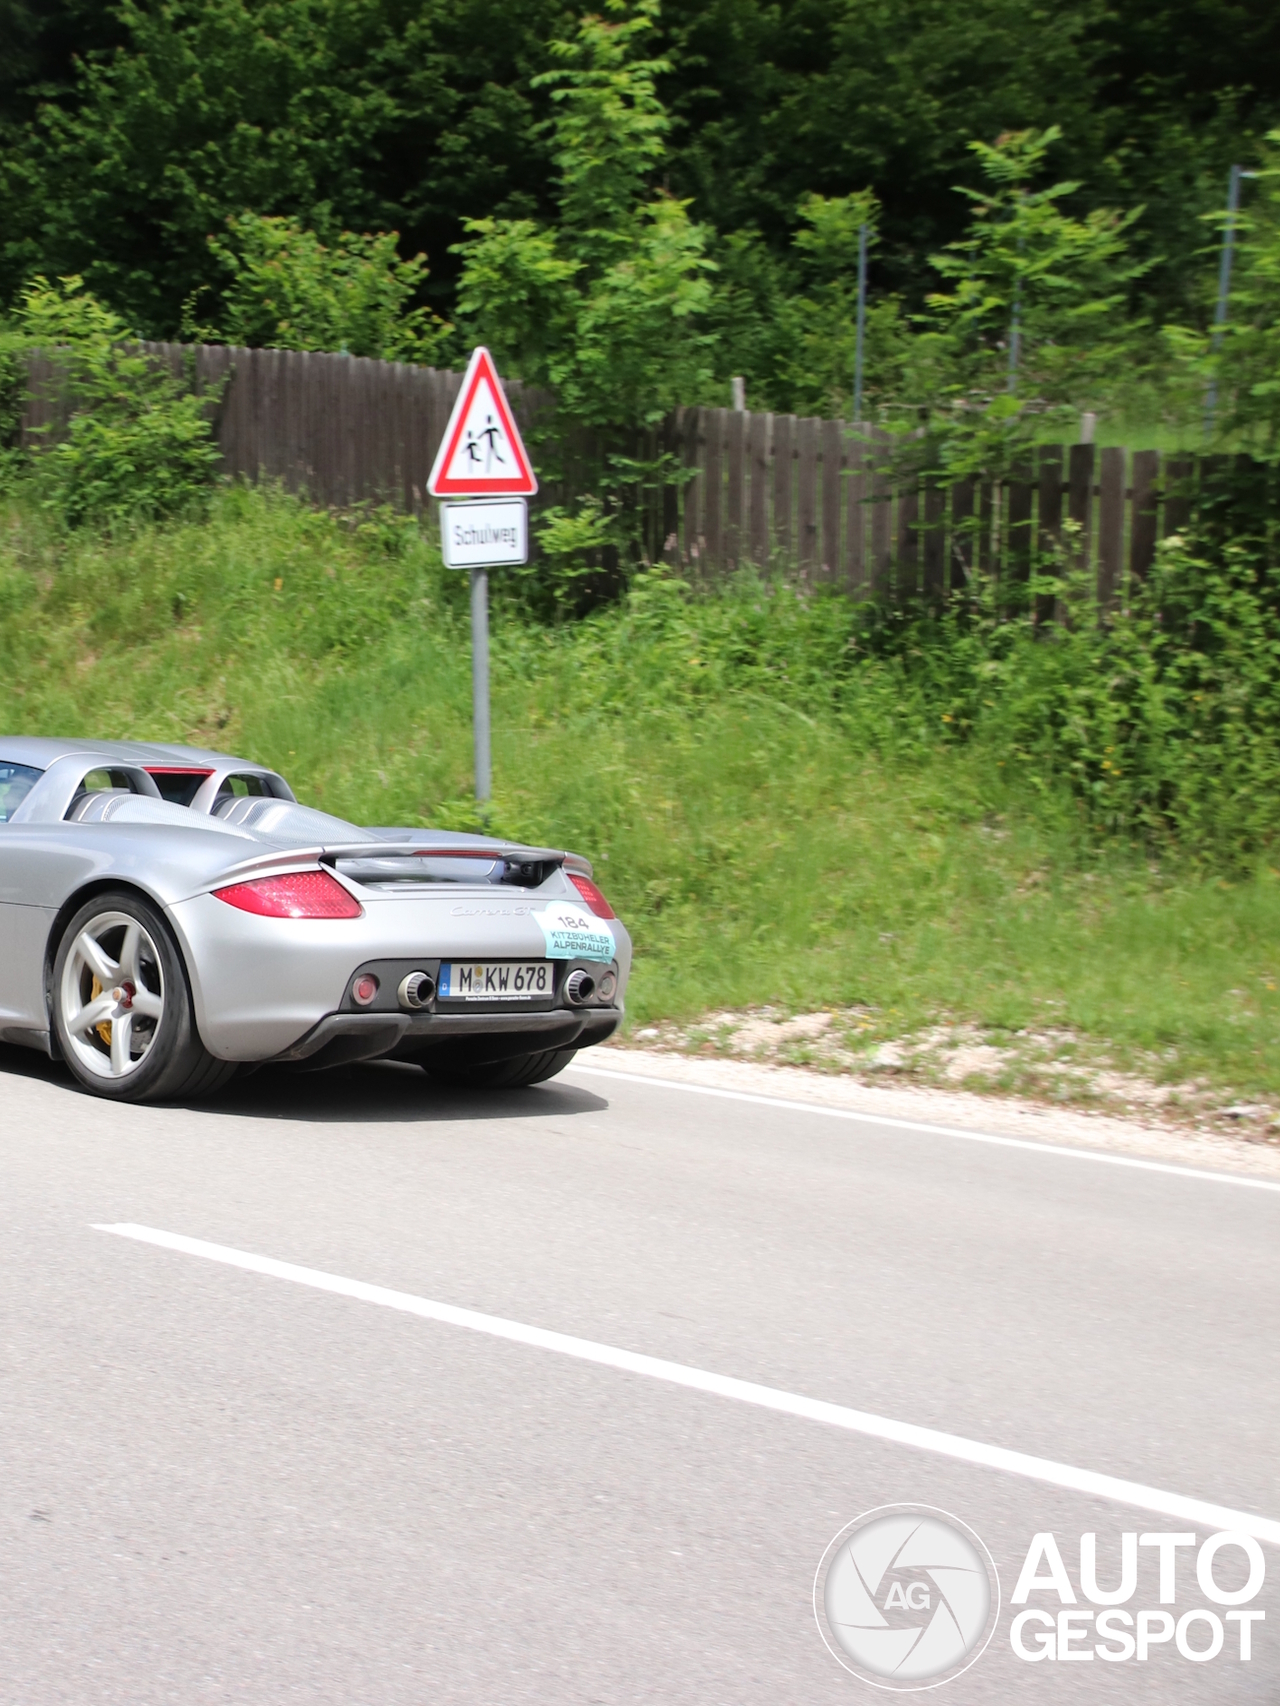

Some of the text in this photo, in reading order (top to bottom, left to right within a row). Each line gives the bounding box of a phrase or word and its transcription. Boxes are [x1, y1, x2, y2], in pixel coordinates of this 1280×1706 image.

[454, 523, 517, 549] Schulweg
[449, 906, 511, 917] Carrera
[557, 916, 590, 930] 184
[553, 940, 610, 955] ALPENRALLYE
[459, 966, 547, 992] M KW 678
